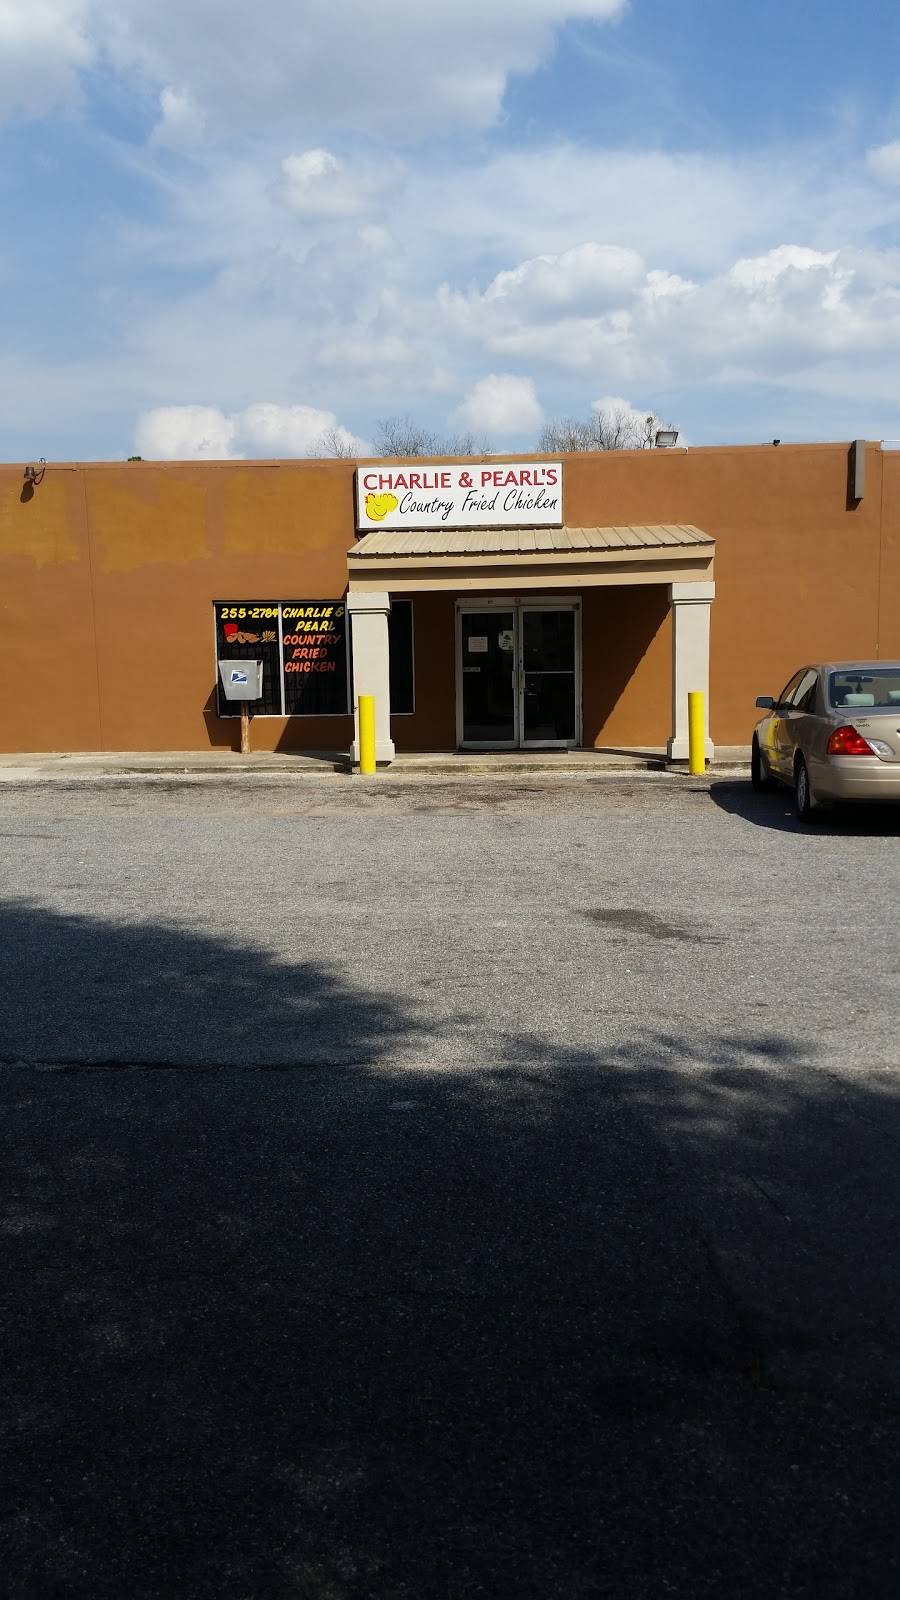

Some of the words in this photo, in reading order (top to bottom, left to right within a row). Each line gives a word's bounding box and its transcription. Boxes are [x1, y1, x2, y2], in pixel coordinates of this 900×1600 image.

[363, 473, 452, 490] CHARLIE
[458, 471, 473, 488] &
[481, 469, 557, 487] PEARL'S
[399, 491, 454, 521] Country
[461, 489, 497, 512] Fried
[503, 488, 558, 512] Chicken
[282, 607, 333, 618] CHARLIE
[335, 606, 344, 617] &
[295, 621, 335, 631] PEARL
[283, 634, 341, 645] COUNTRY
[292, 647, 328, 659] FRIED
[284, 662, 336, 672] CHICKEN
